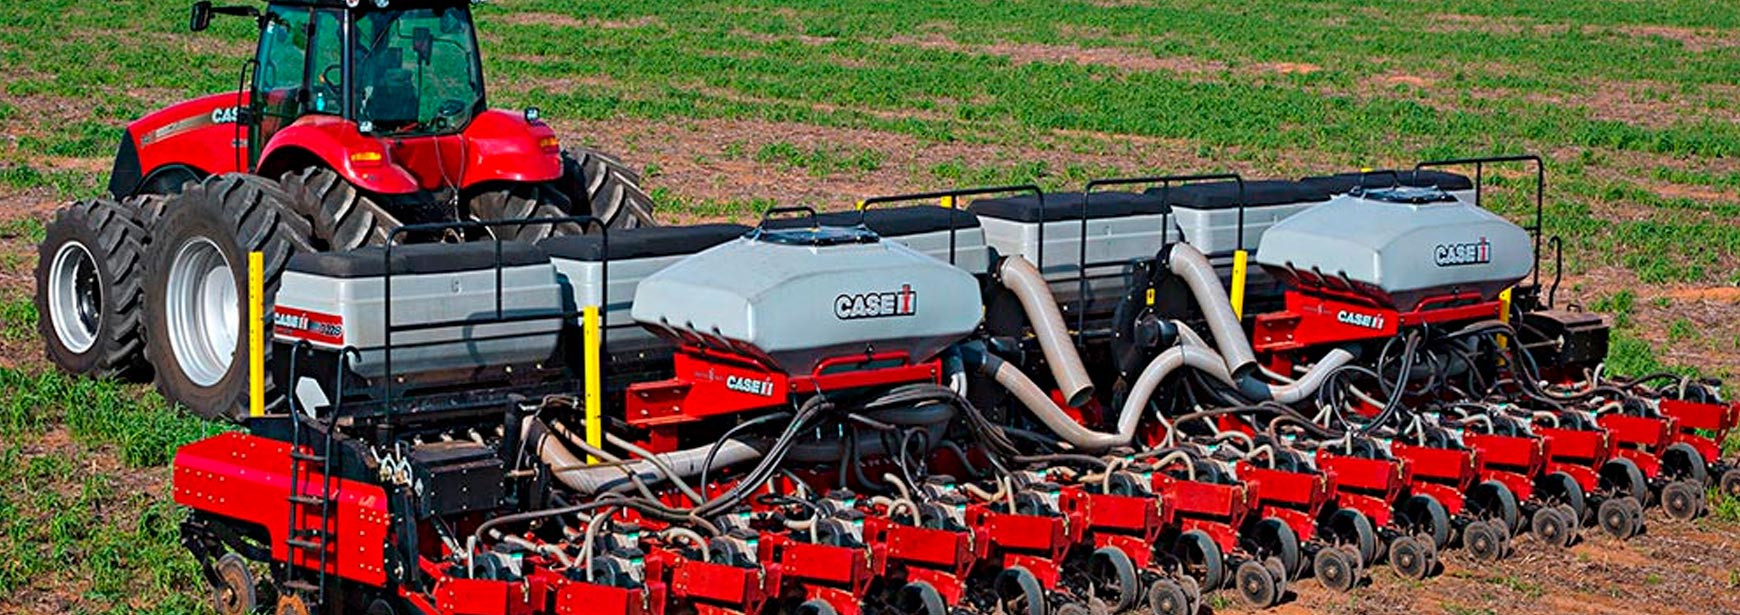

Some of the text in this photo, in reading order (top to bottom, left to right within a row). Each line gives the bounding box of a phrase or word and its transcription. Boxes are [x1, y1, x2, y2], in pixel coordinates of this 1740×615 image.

[211, 106, 240, 124] CAS
[1434, 244, 1477, 267] CASE
[834, 293, 897, 320] CASE
[1337, 310, 1371, 328] CASE
[726, 375, 760, 394] CASE
